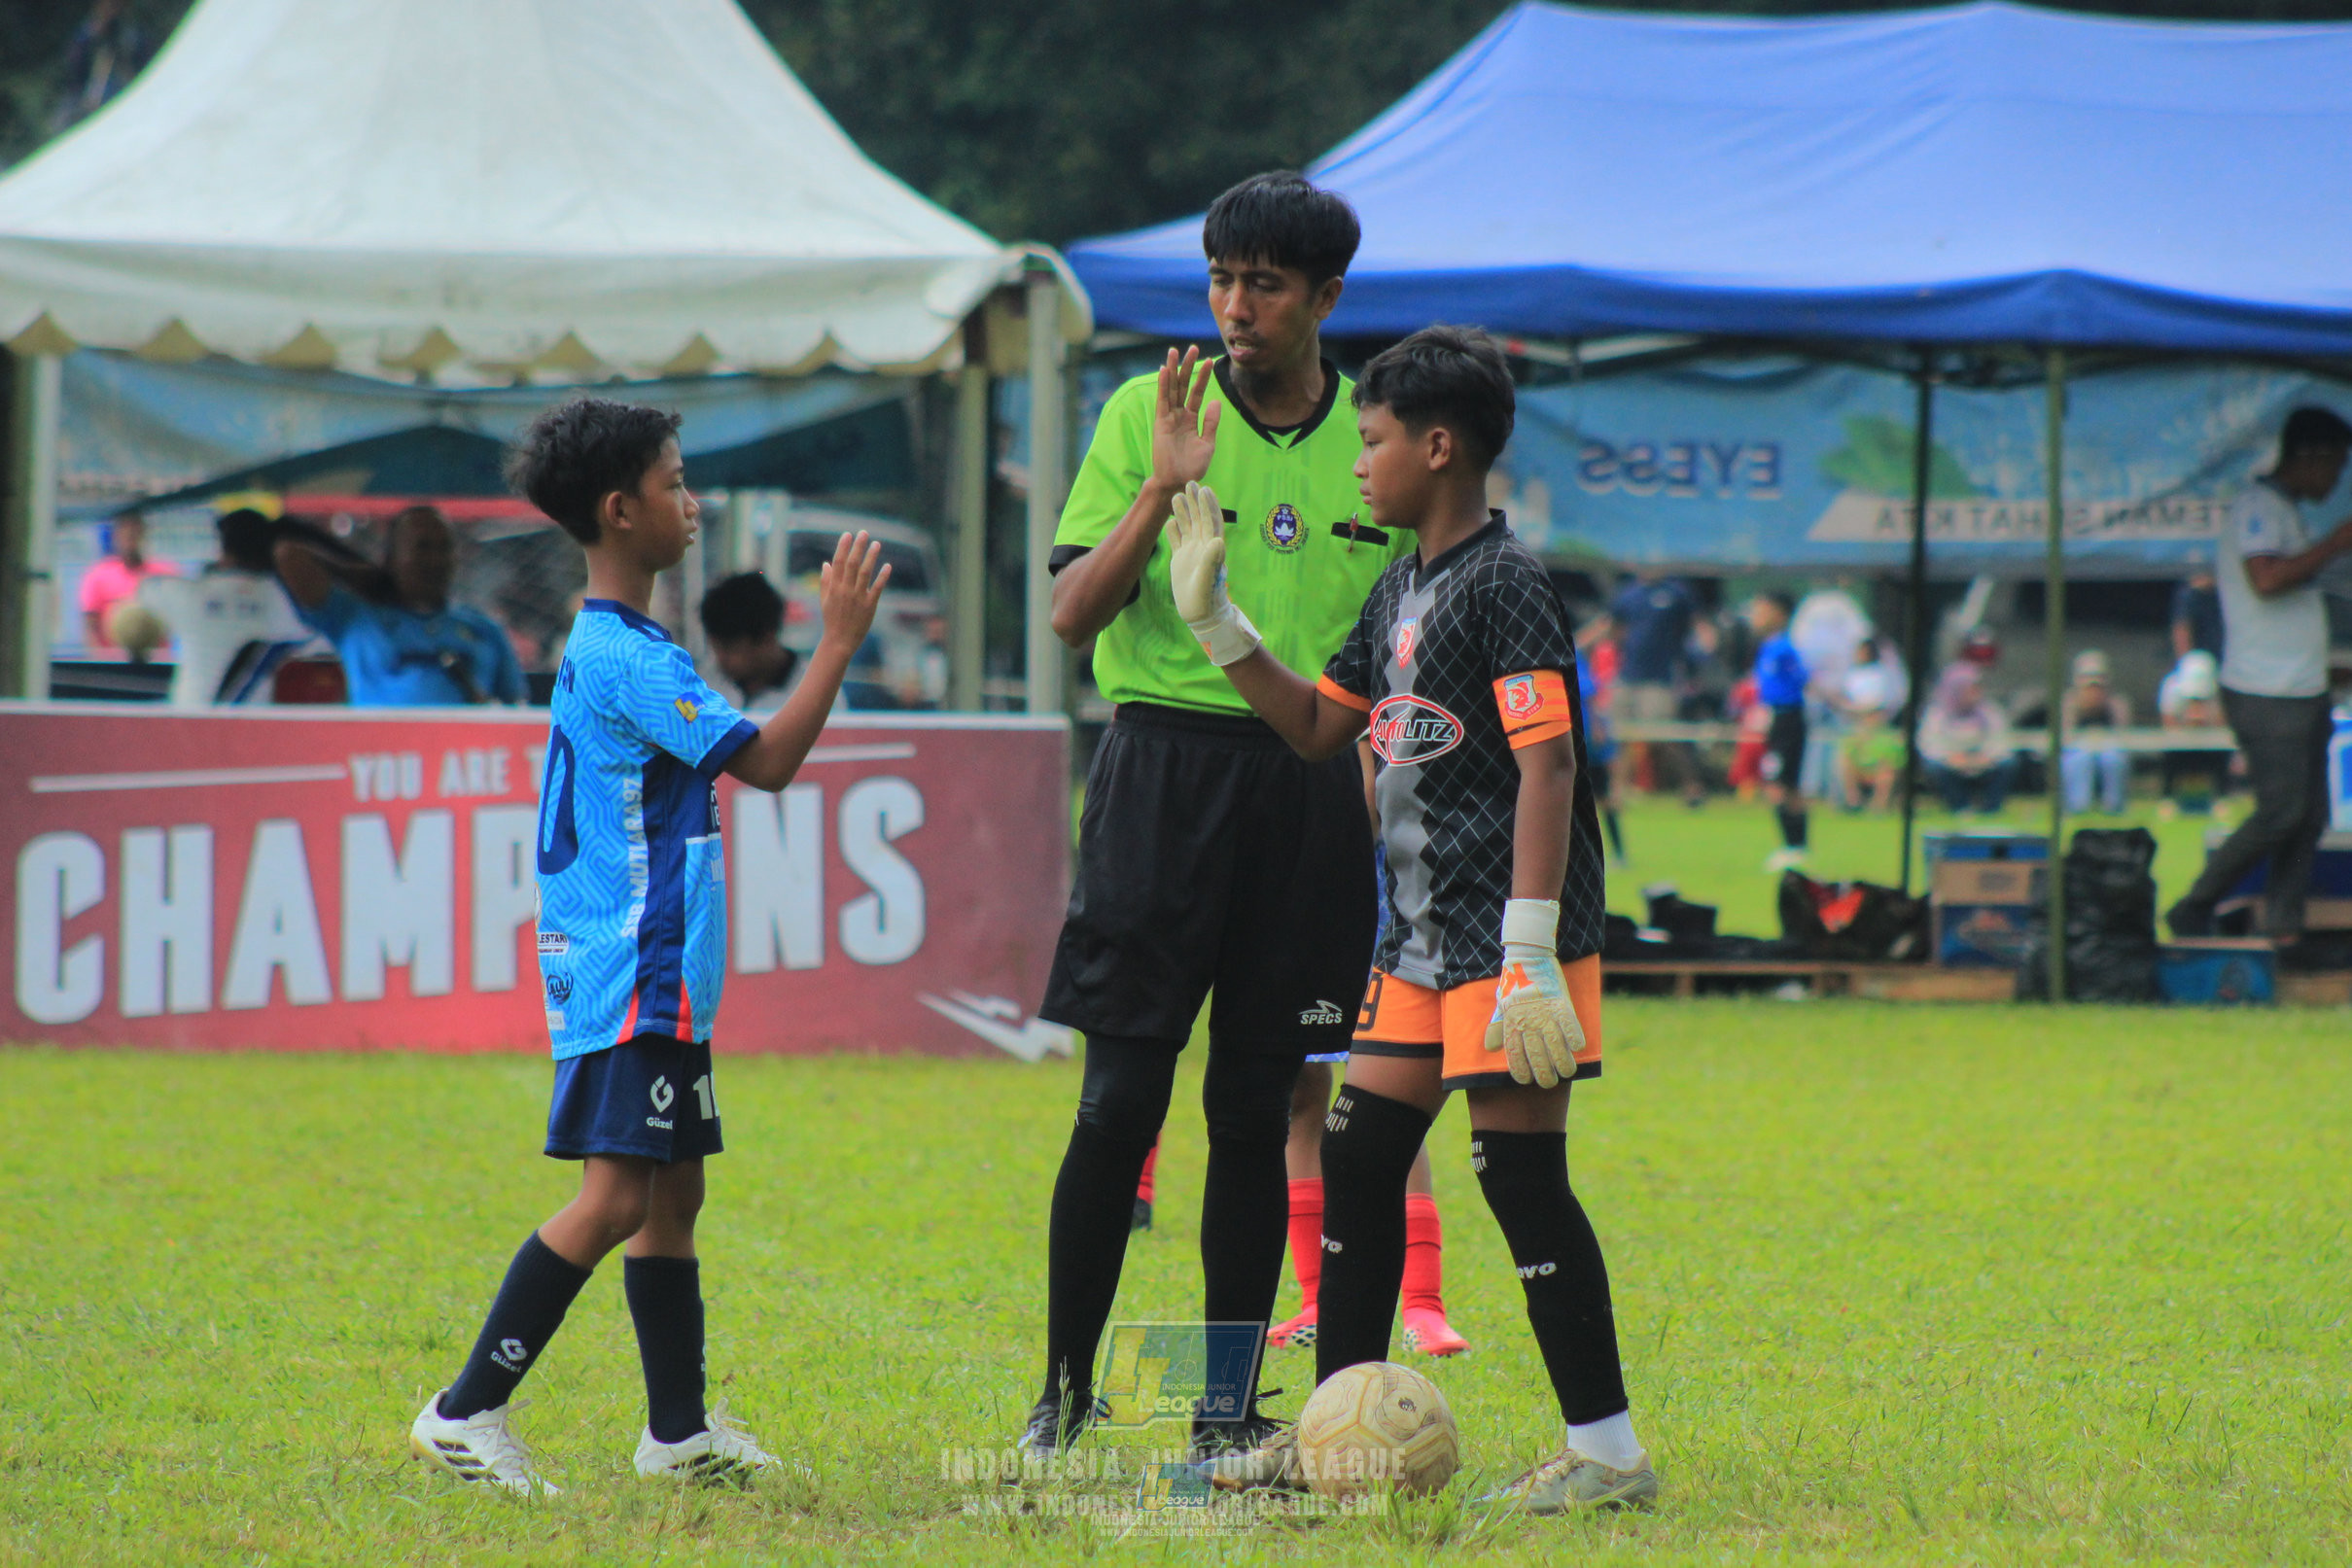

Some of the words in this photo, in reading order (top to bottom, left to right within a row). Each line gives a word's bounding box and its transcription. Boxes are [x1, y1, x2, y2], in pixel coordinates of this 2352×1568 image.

[348, 750, 423, 802] YOU
[439, 746, 510, 798] ARE
[15, 776, 927, 1026] CHAMPNS
[620, 903, 646, 938] SSB
[1300, 1013, 1343, 1026] SPECS
